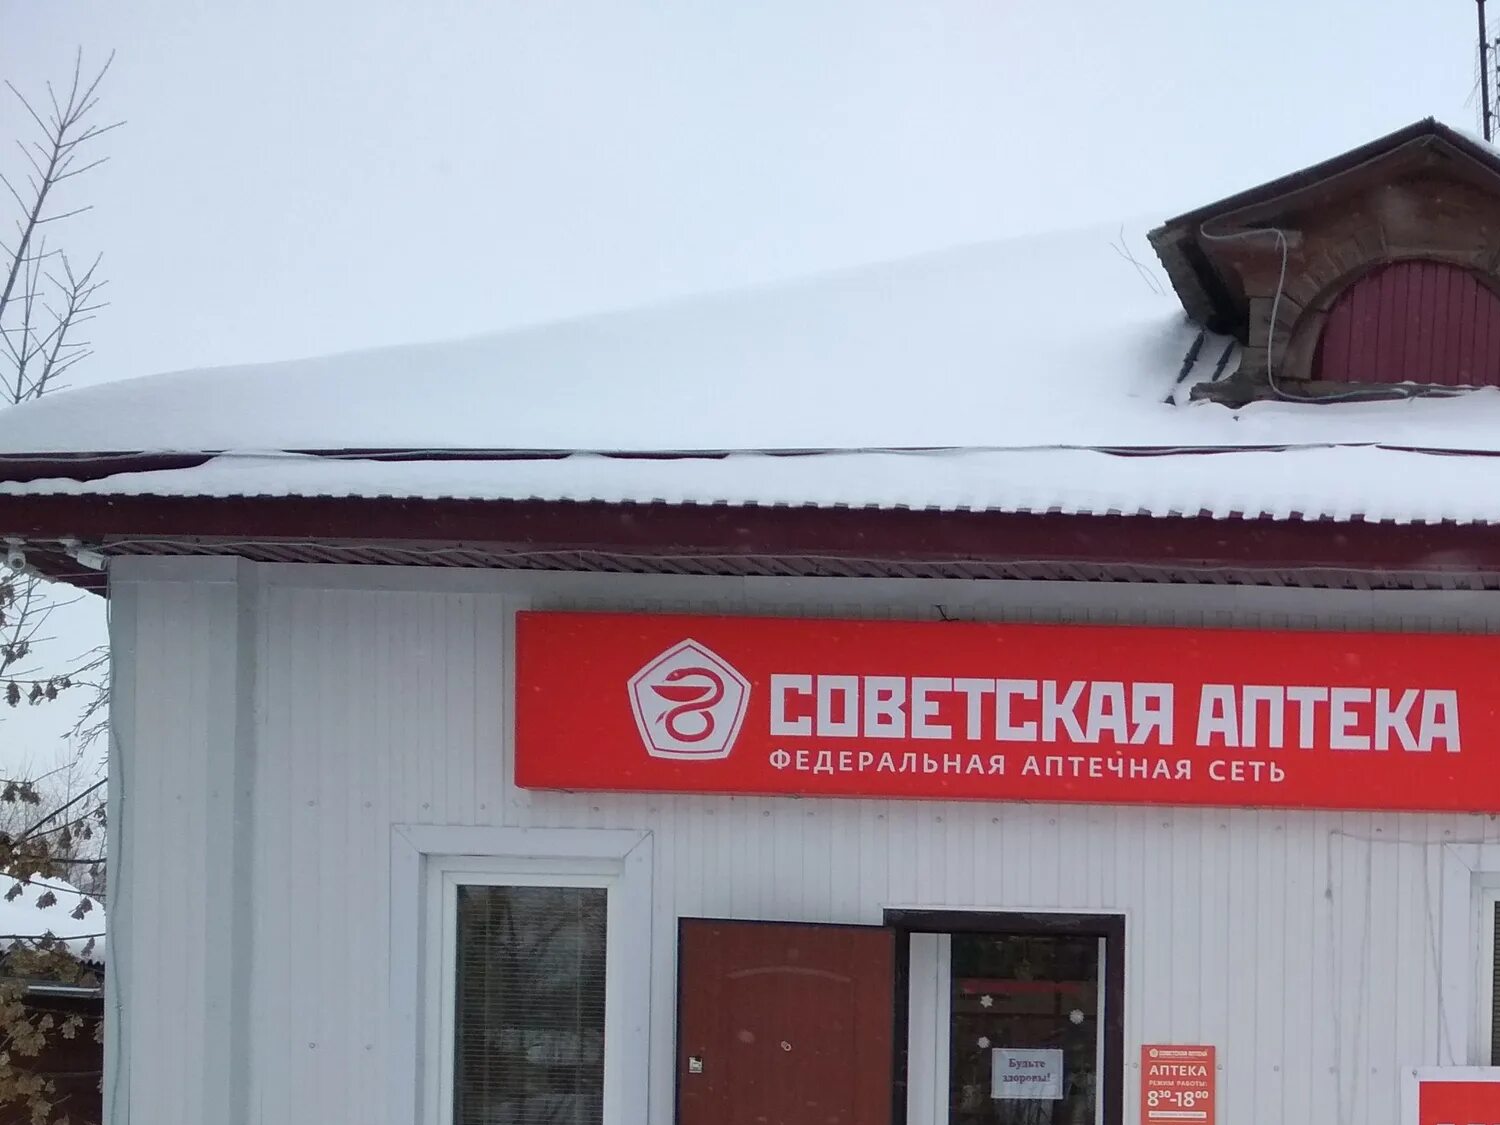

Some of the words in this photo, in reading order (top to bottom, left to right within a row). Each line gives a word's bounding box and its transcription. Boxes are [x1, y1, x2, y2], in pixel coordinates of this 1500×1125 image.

[769, 674, 1173, 744] СОВЕТСКАЯ
[1196, 684, 1460, 753] АПТЕКА
[769, 749, 1005, 777] ФЕДЕРАЛЬНАЯ
[1022, 755, 1192, 781] АПТЕЧНАЯ
[1208, 761, 1286, 783] СЕТЬ
[1008, 1058, 1046, 1070] Будьте
[1149, 1064, 1207, 1077] АПТЕКА
